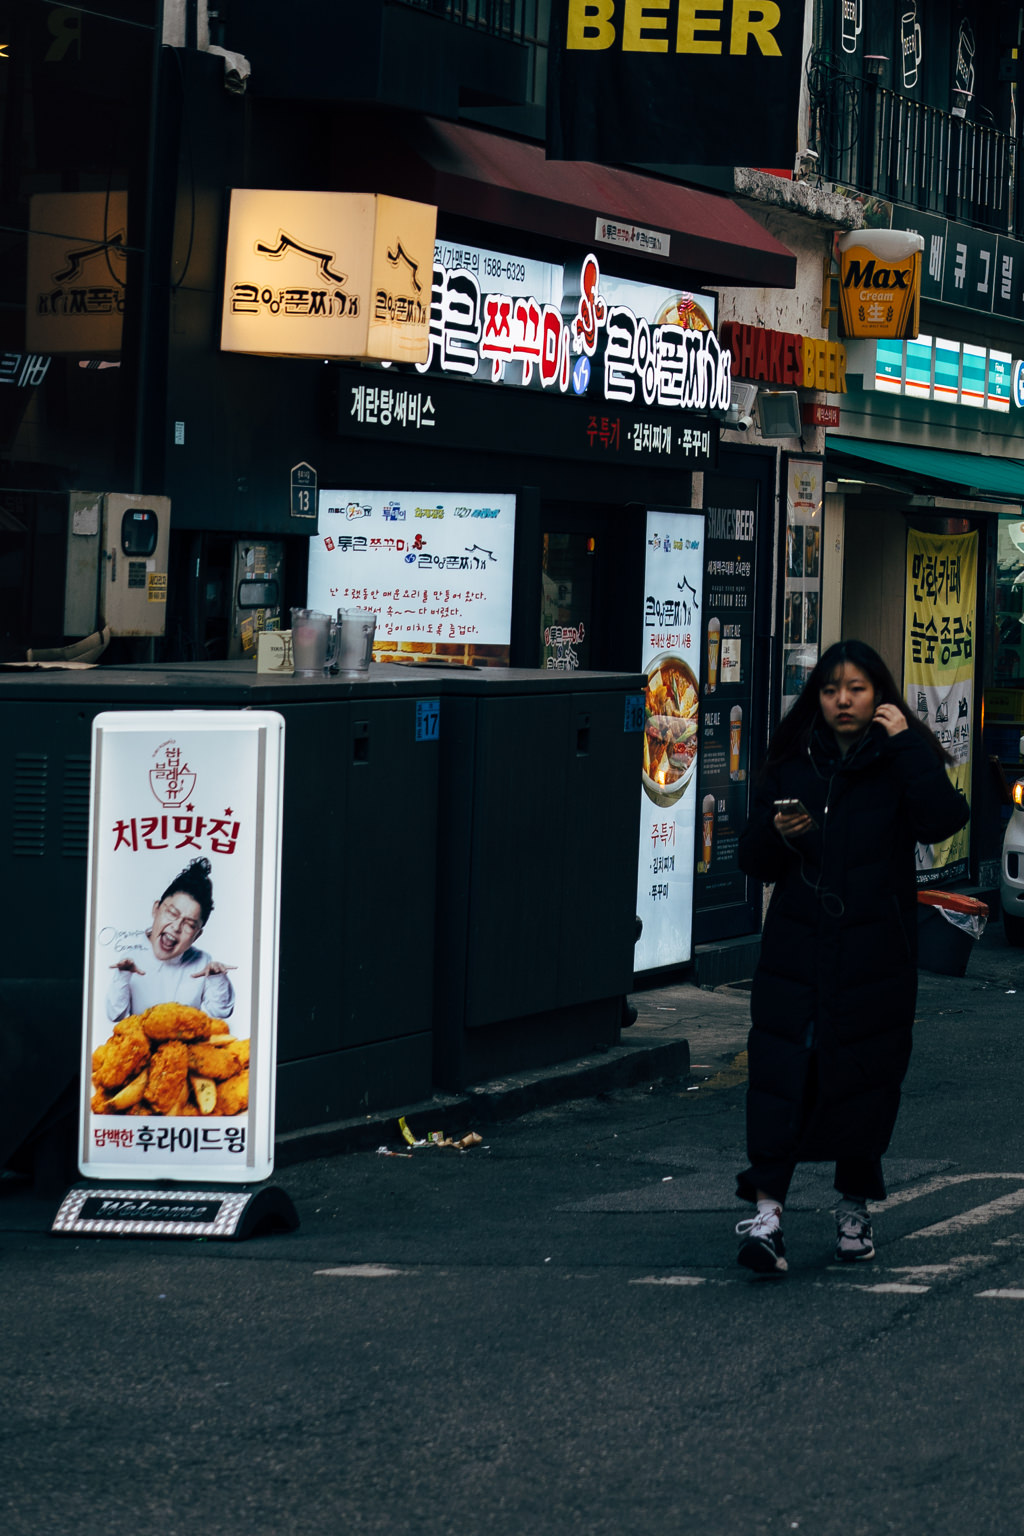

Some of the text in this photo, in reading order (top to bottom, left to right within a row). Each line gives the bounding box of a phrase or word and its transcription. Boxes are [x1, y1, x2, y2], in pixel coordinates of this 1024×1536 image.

[843, 0, 856, 21] BEER
[483, 256, 526, 283] 1588-6329
[844, 260, 911, 289] Max
[859, 290, 894, 301] Cream
[867, 302, 886, 322] 生
[721, 320, 848, 394] SHAKESBEER
[350, 385, 436, 429] 계란탕써비스
[587, 416, 621, 451] 주특기
[633, 422, 672, 455] 김치찌개
[298, 490, 310, 511] 13
[911, 553, 962, 606] 만화카페
[422, 713, 439, 737] 17
[630, 706, 643, 728] 18
[112, 815, 241, 855] 치킨맛집
[650, 821, 676, 849] 주특기
[93, 1125, 247, 1153] 담백한 후라이드윙
[96, 1199, 208, 1219] Welcome
